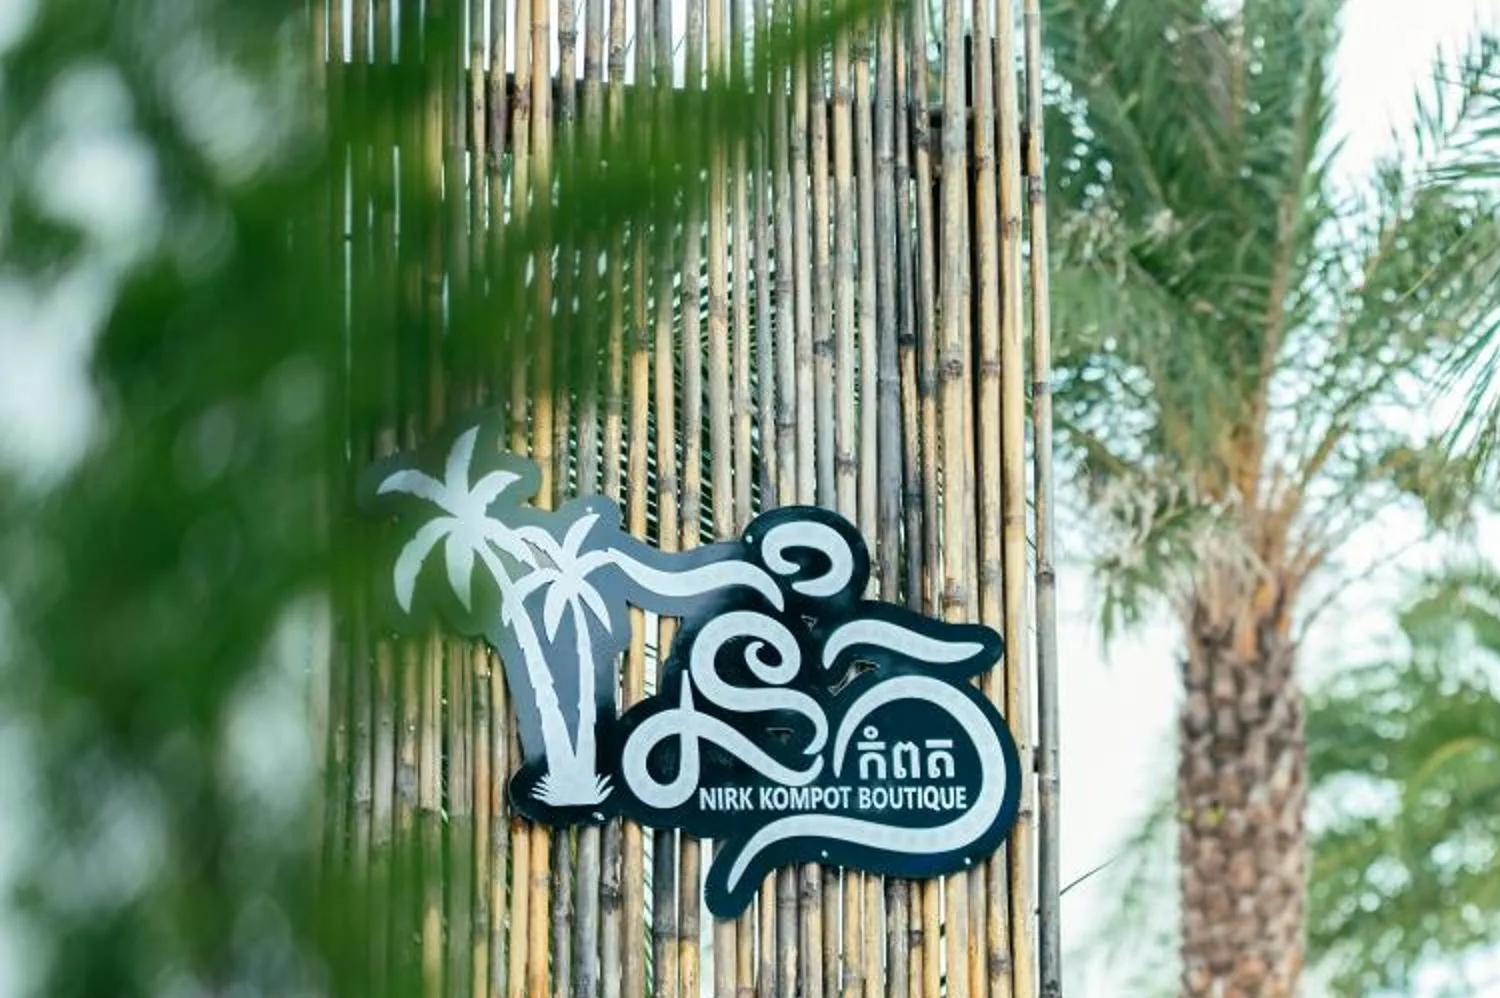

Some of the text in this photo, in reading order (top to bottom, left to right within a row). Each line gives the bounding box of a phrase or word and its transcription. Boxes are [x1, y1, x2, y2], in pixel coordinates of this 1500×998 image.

[699, 785, 968, 811] NIRK KOMPOT BOUTIQUE
